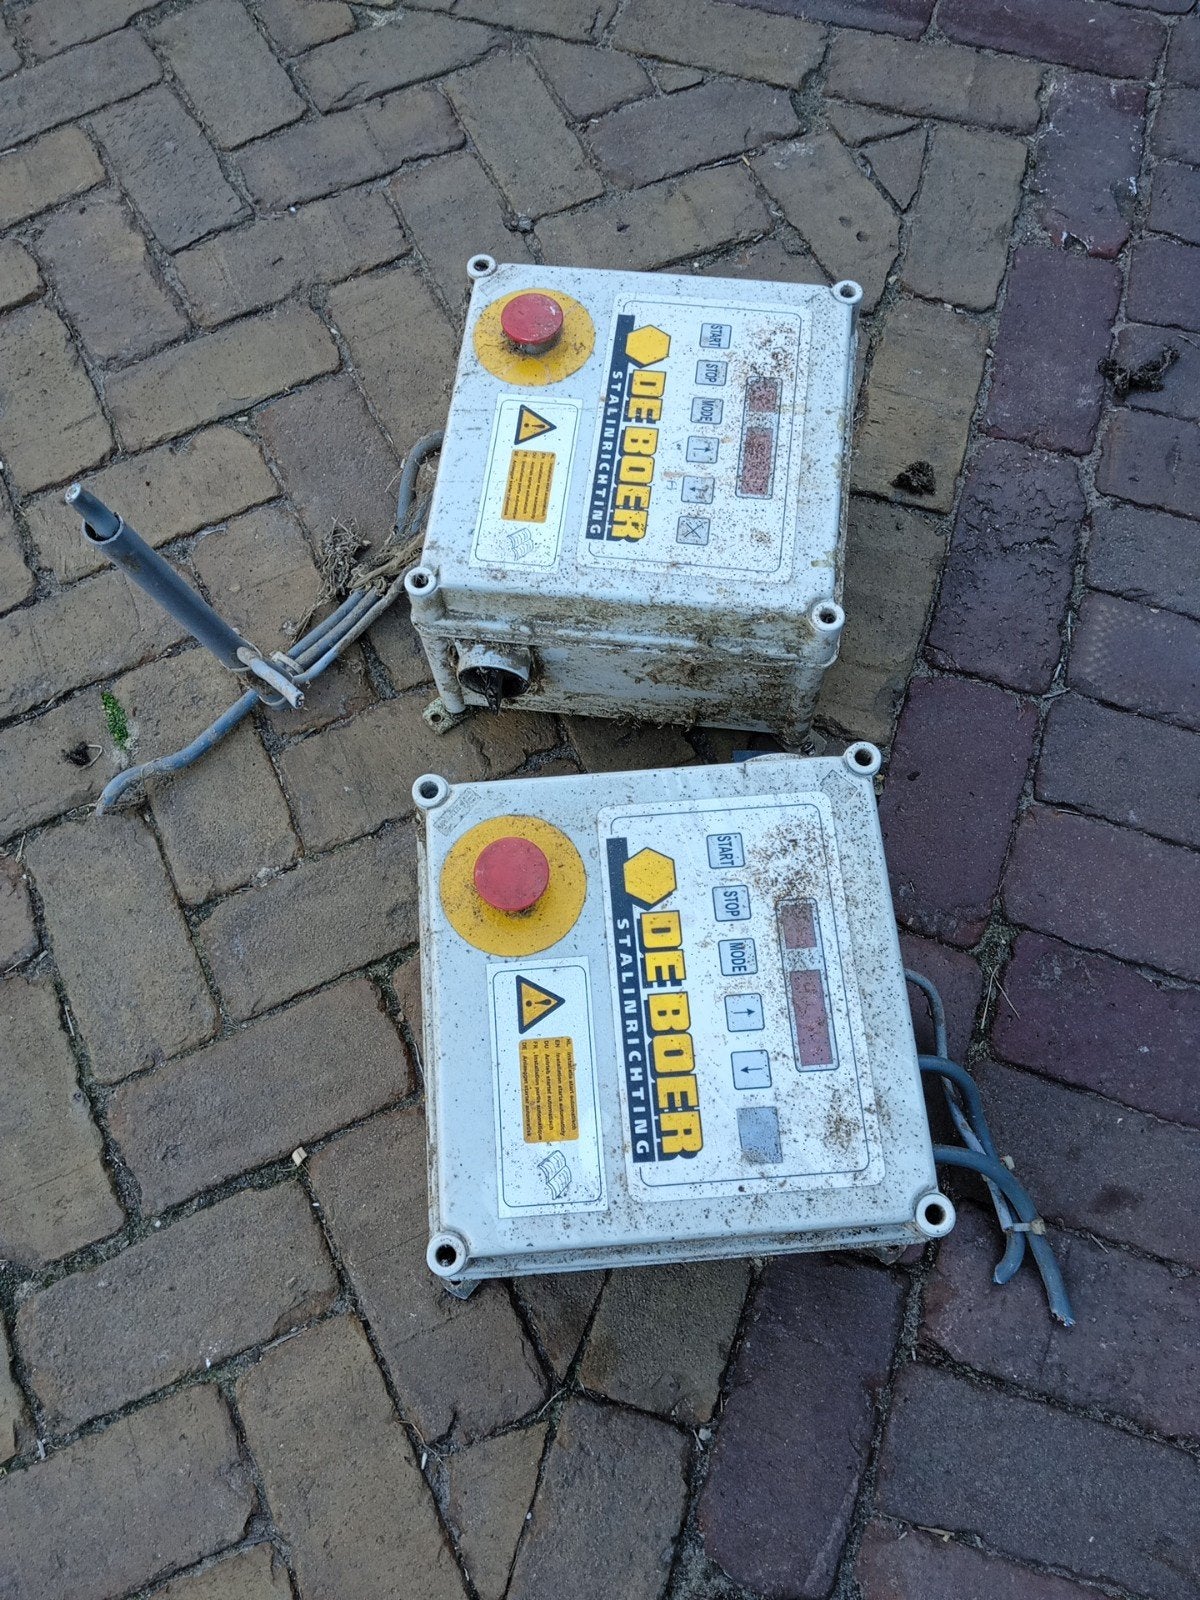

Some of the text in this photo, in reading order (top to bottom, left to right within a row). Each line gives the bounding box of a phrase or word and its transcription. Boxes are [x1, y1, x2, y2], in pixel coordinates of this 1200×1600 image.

[709, 323, 723, 348] START
[705, 363, 718, 383] STOP
[700, 399, 714, 422] MODE
[590, 370, 622, 534] STALINRICHTING
[607, 369, 666, 543] DE BOER
[717, 834, 734, 867] START
[723, 890, 741, 917] STOP
[729, 942, 747, 973] MODE
[617, 918, 650, 1155] STALINRICHTING
[637, 910, 703, 1162] DE BOER
